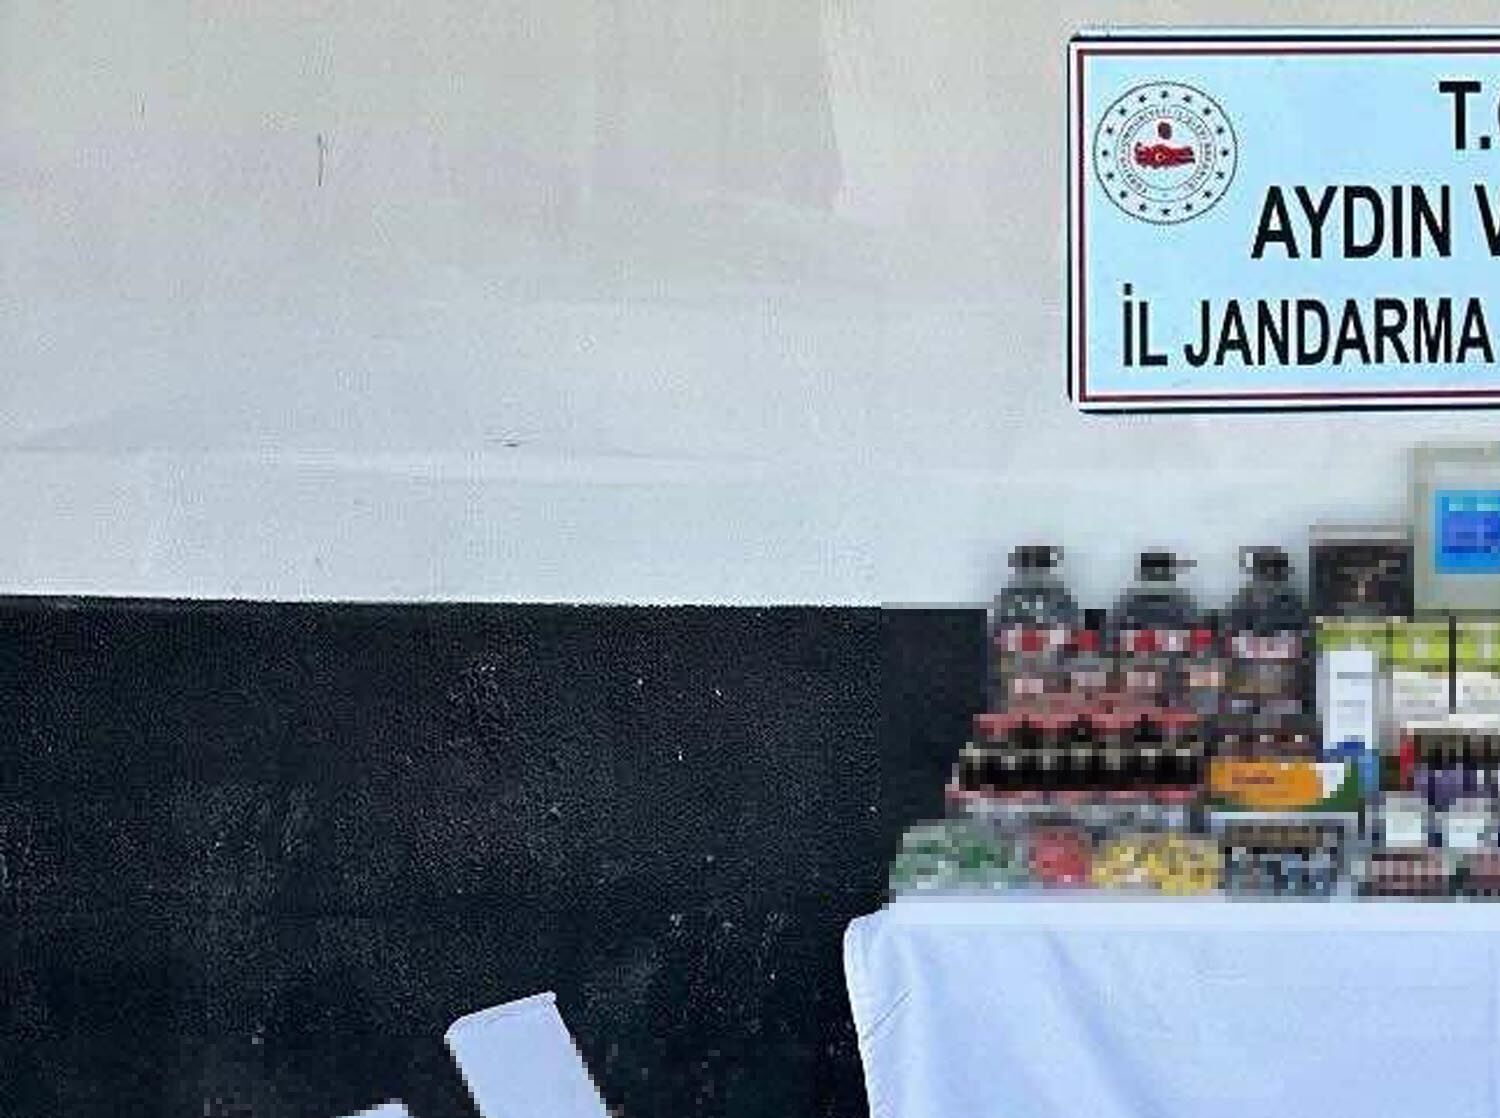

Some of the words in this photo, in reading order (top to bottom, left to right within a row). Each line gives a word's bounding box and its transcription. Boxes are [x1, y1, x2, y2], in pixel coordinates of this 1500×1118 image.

[1250, 184, 1453, 259] AYDIN
[1123, 283, 1168, 367] İL
[1183, 296, 1495, 368] JANDARMA
